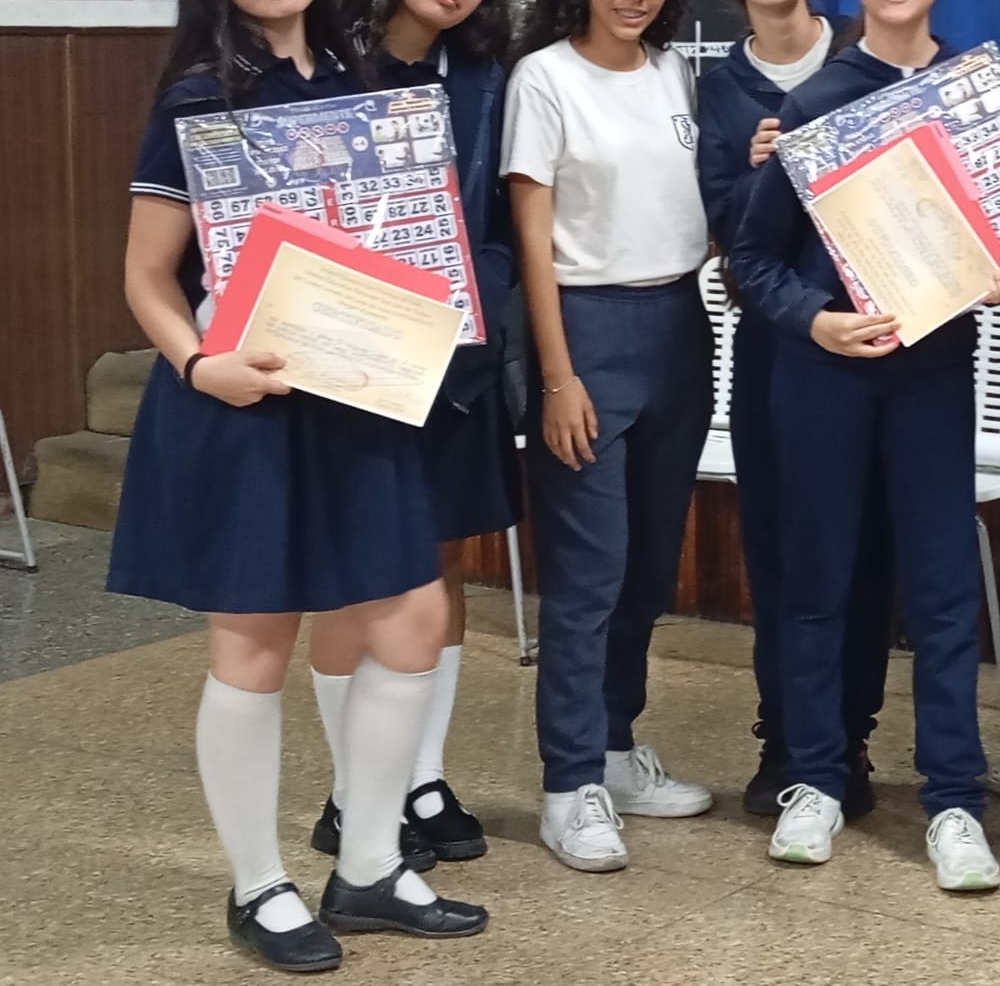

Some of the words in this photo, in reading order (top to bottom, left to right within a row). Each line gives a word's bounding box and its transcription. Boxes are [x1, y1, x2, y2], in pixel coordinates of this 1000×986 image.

[982, 123, 999, 137] 34
[359, 179, 377, 193] 32
[383, 177, 400, 190] 33
[983, 173, 1000, 187] 23
[232, 199, 251, 213] 67
[279, 192, 298, 205] 69
[392, 228, 411, 240] 23
[414, 224, 433, 237] 24
